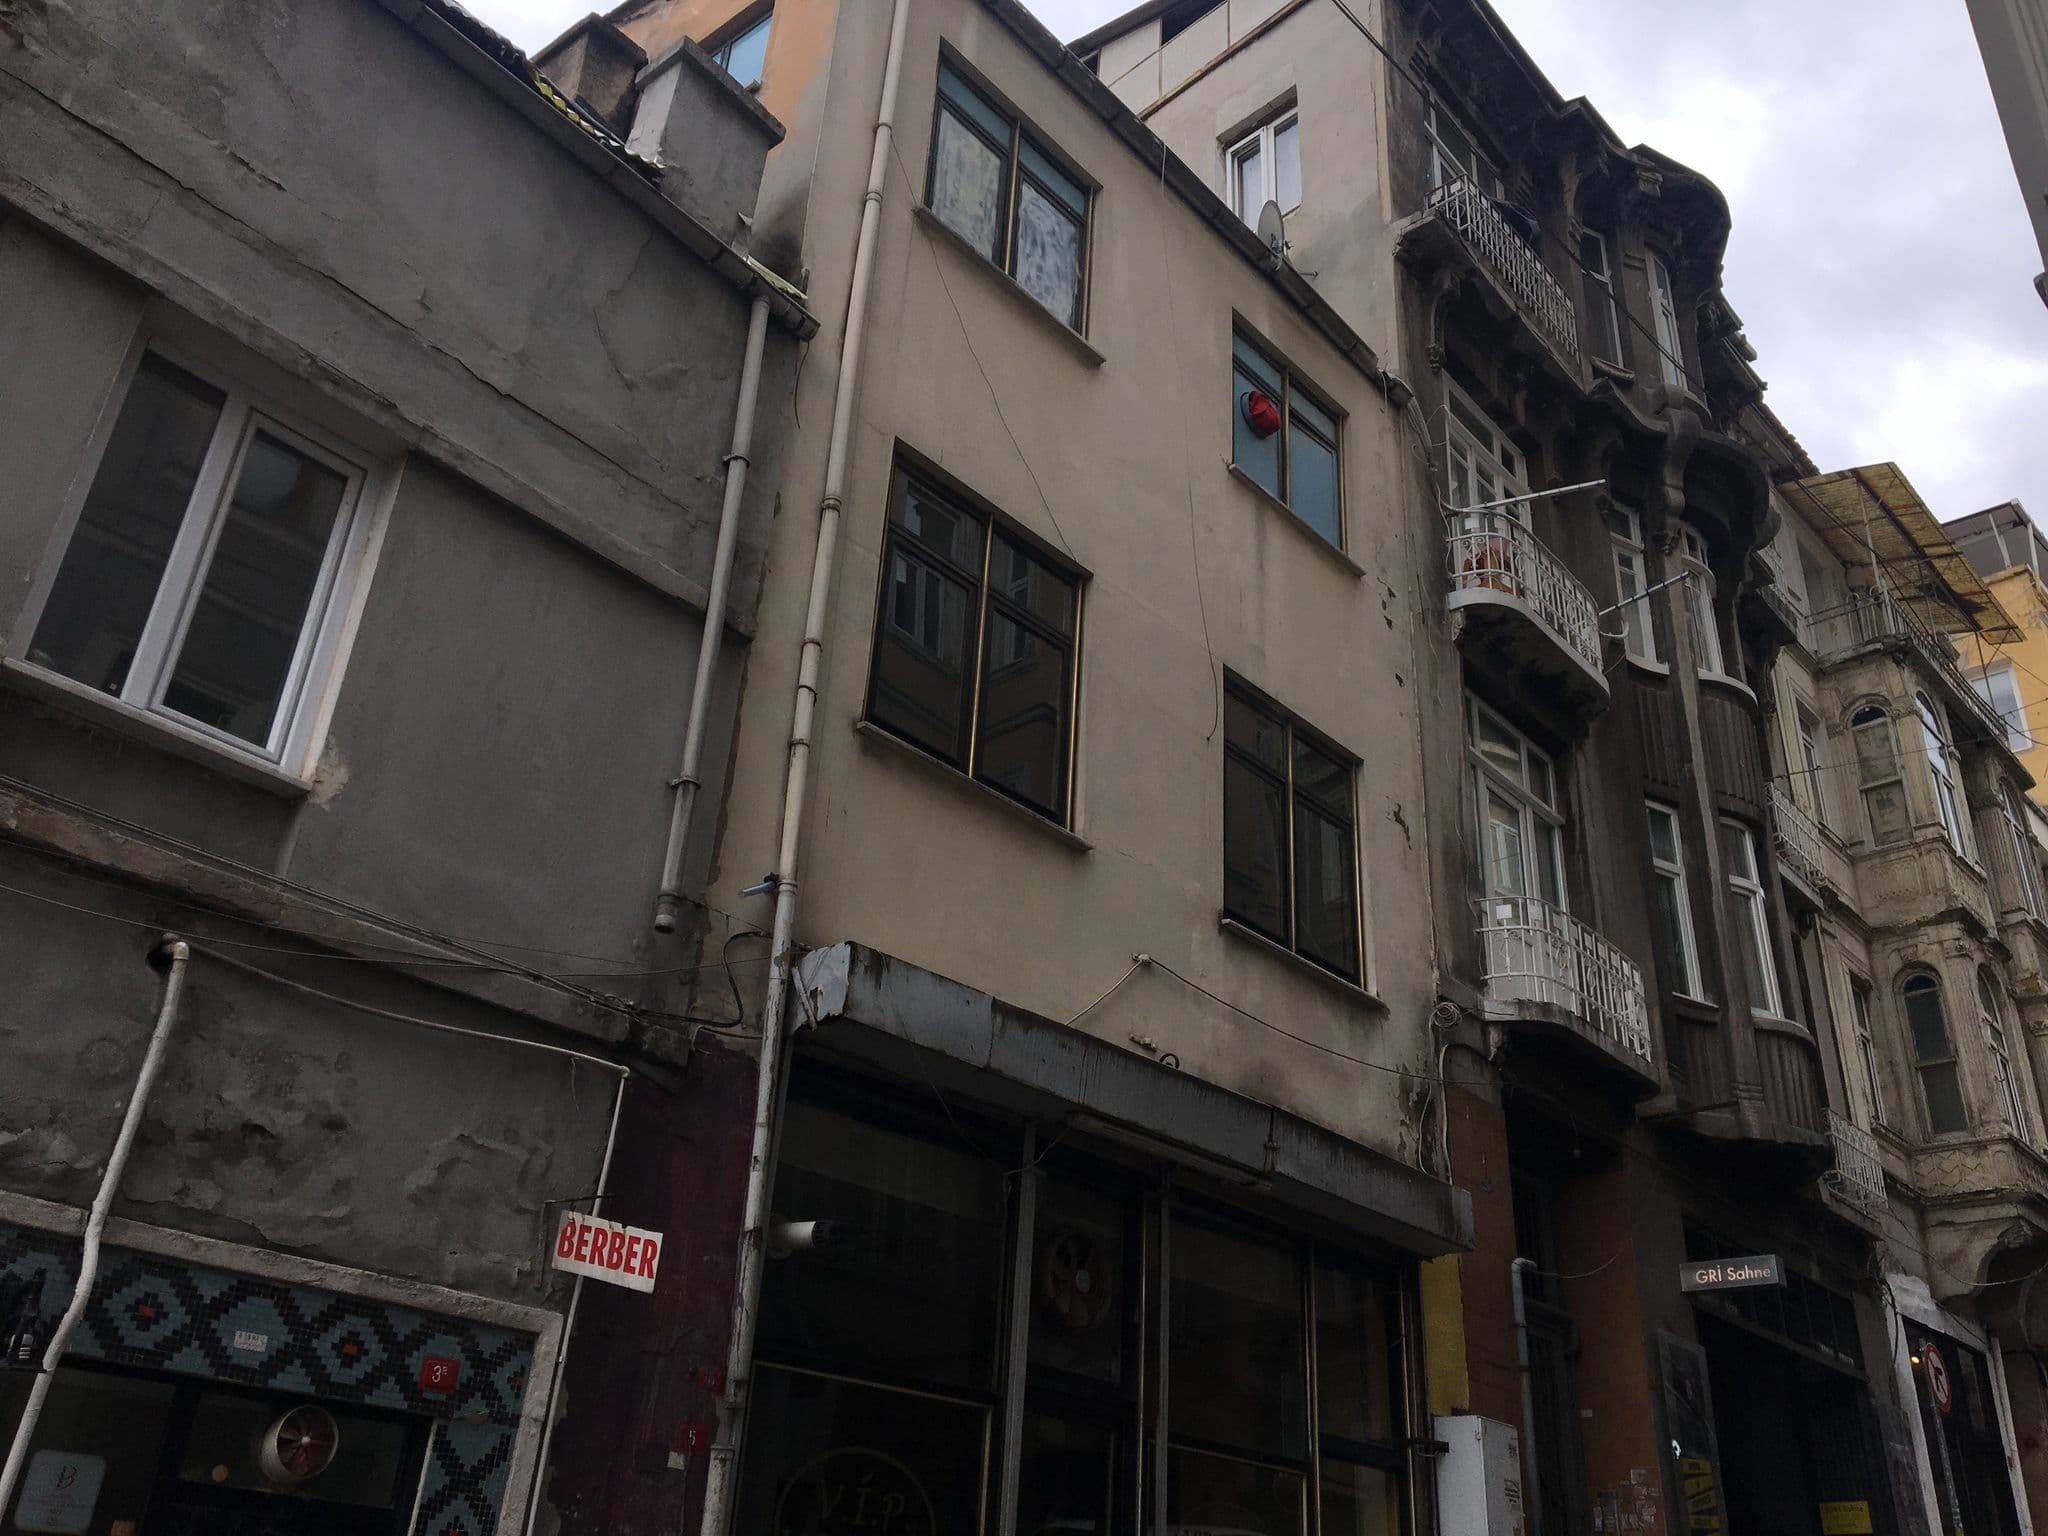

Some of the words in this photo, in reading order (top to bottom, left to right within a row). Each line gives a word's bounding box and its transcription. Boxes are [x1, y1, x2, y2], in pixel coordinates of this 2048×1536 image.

[557, 1221, 657, 1279] BERBER
[1695, 1264, 1722, 1284] GRİ
[1726, 1264, 1771, 1281] Sahne
